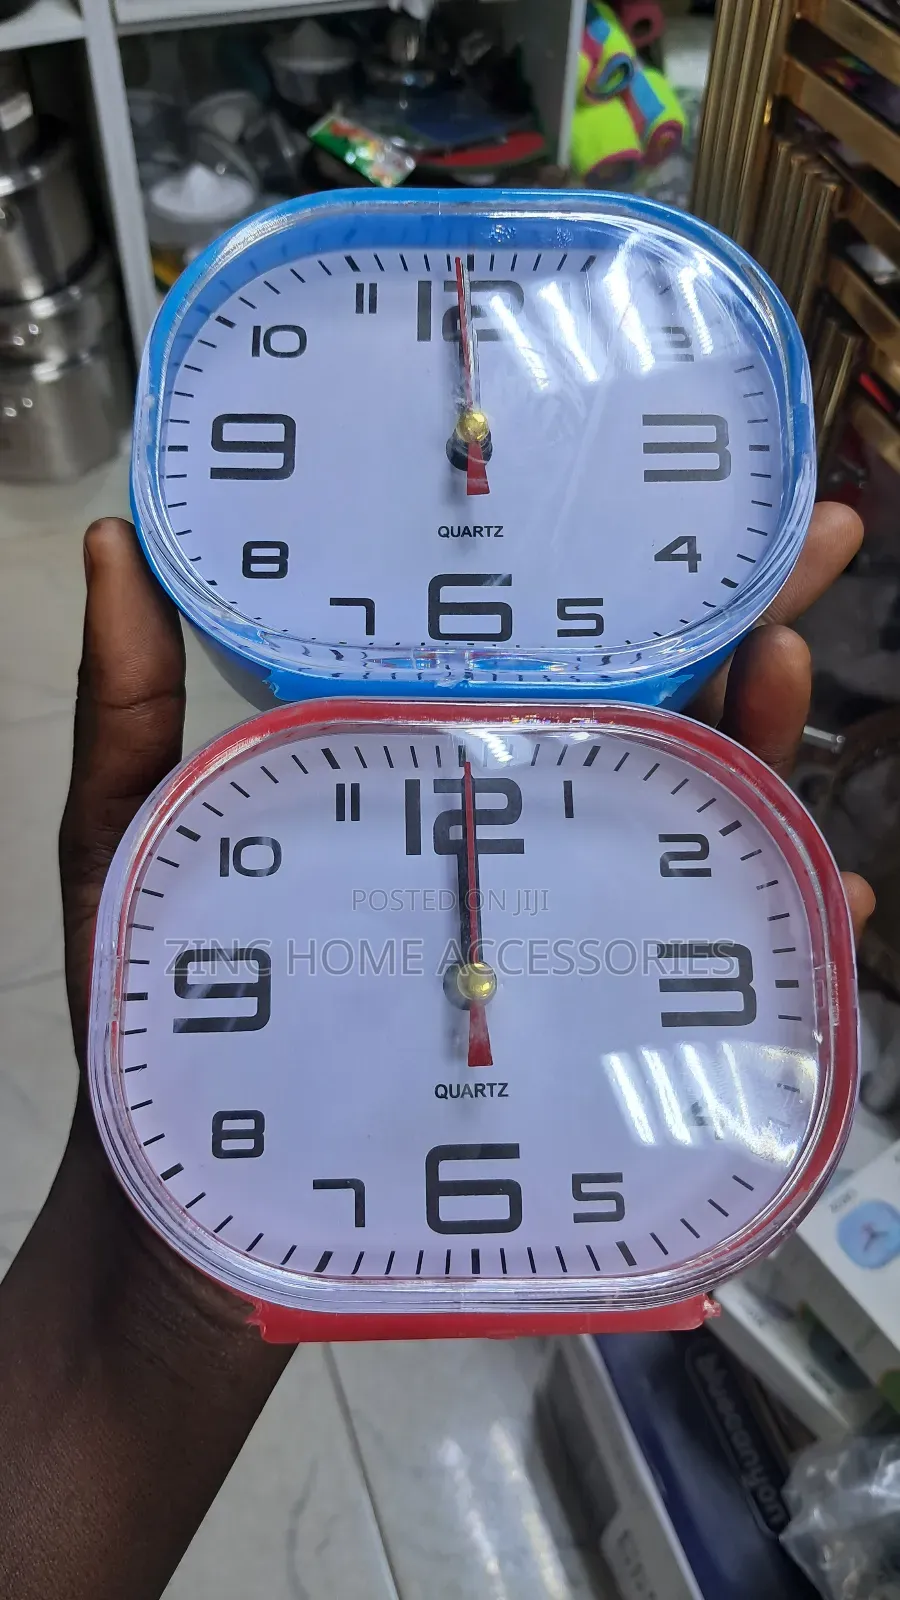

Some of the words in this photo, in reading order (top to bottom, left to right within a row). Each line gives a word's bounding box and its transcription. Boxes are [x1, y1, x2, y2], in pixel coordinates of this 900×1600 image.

[416, 280, 524, 342] 12
[252, 325, 307, 358] 10
[210, 414, 296, 480] 9
[642, 414, 731, 482] 3
[438, 526, 503, 538] QUARTZ
[654, 536, 701, 573] 4
[242, 541, 288, 579] 8
[330, 598, 375, 635] 7
[428, 574, 512, 641] 6
[557, 598, 604, 637] 5
[405, 778, 524, 855] 12
[564, 780, 574, 818] 1
[220, 837, 281, 877] 10
[659, 833, 712, 877] 2
[173, 948, 271, 1033] 9
[657, 943, 757, 1027] 3
[435, 1083, 508, 1099] QUARTZ
[212, 1110, 265, 1159] 8
[313, 1179, 365, 1227] 7
[425, 1143, 522, 1234] 6
[572, 1172, 625, 1223] 5
